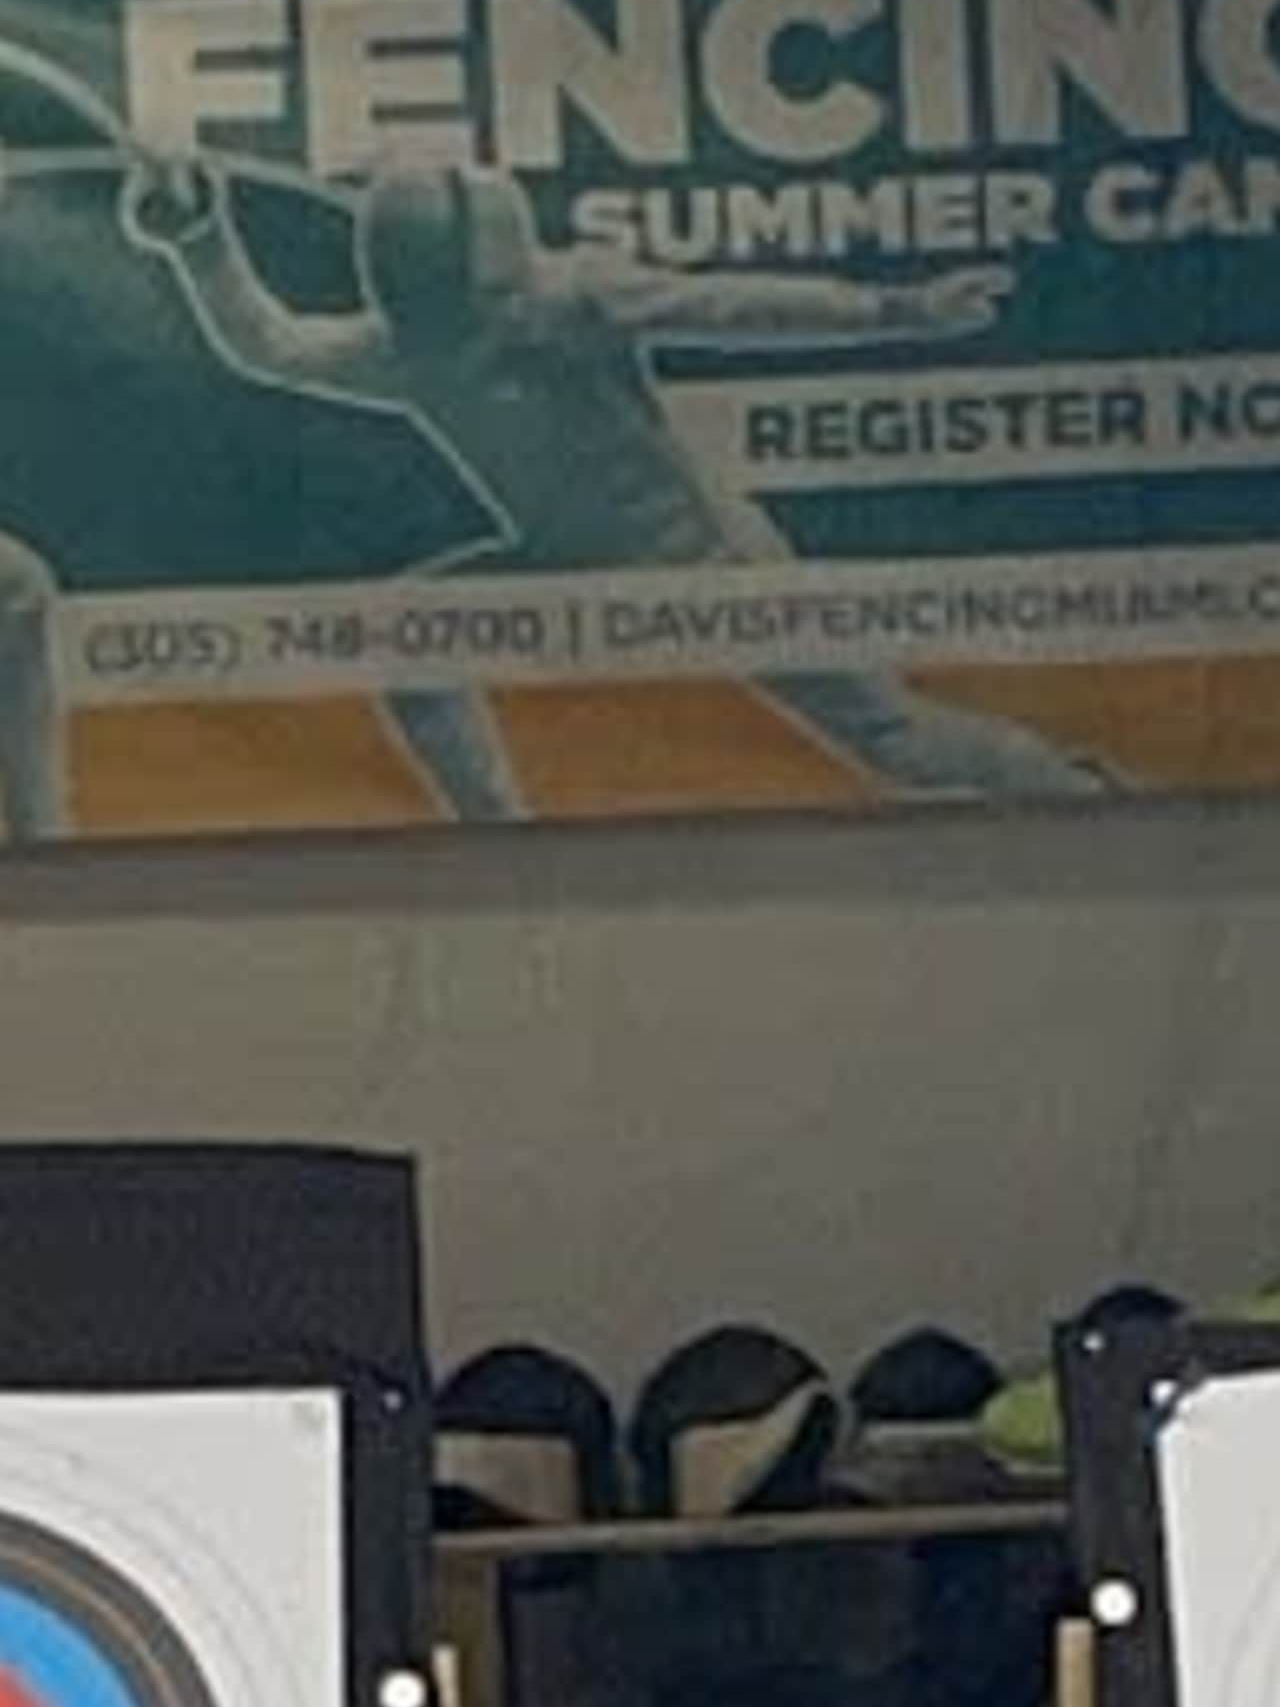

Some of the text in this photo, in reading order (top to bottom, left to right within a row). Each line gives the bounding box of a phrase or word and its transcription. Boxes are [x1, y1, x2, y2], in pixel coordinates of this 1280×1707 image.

[572, 168, 1058, 264] SUMMER
[744, 388, 1150, 462] REGISTER
[83, 618, 241, 672] (305)
